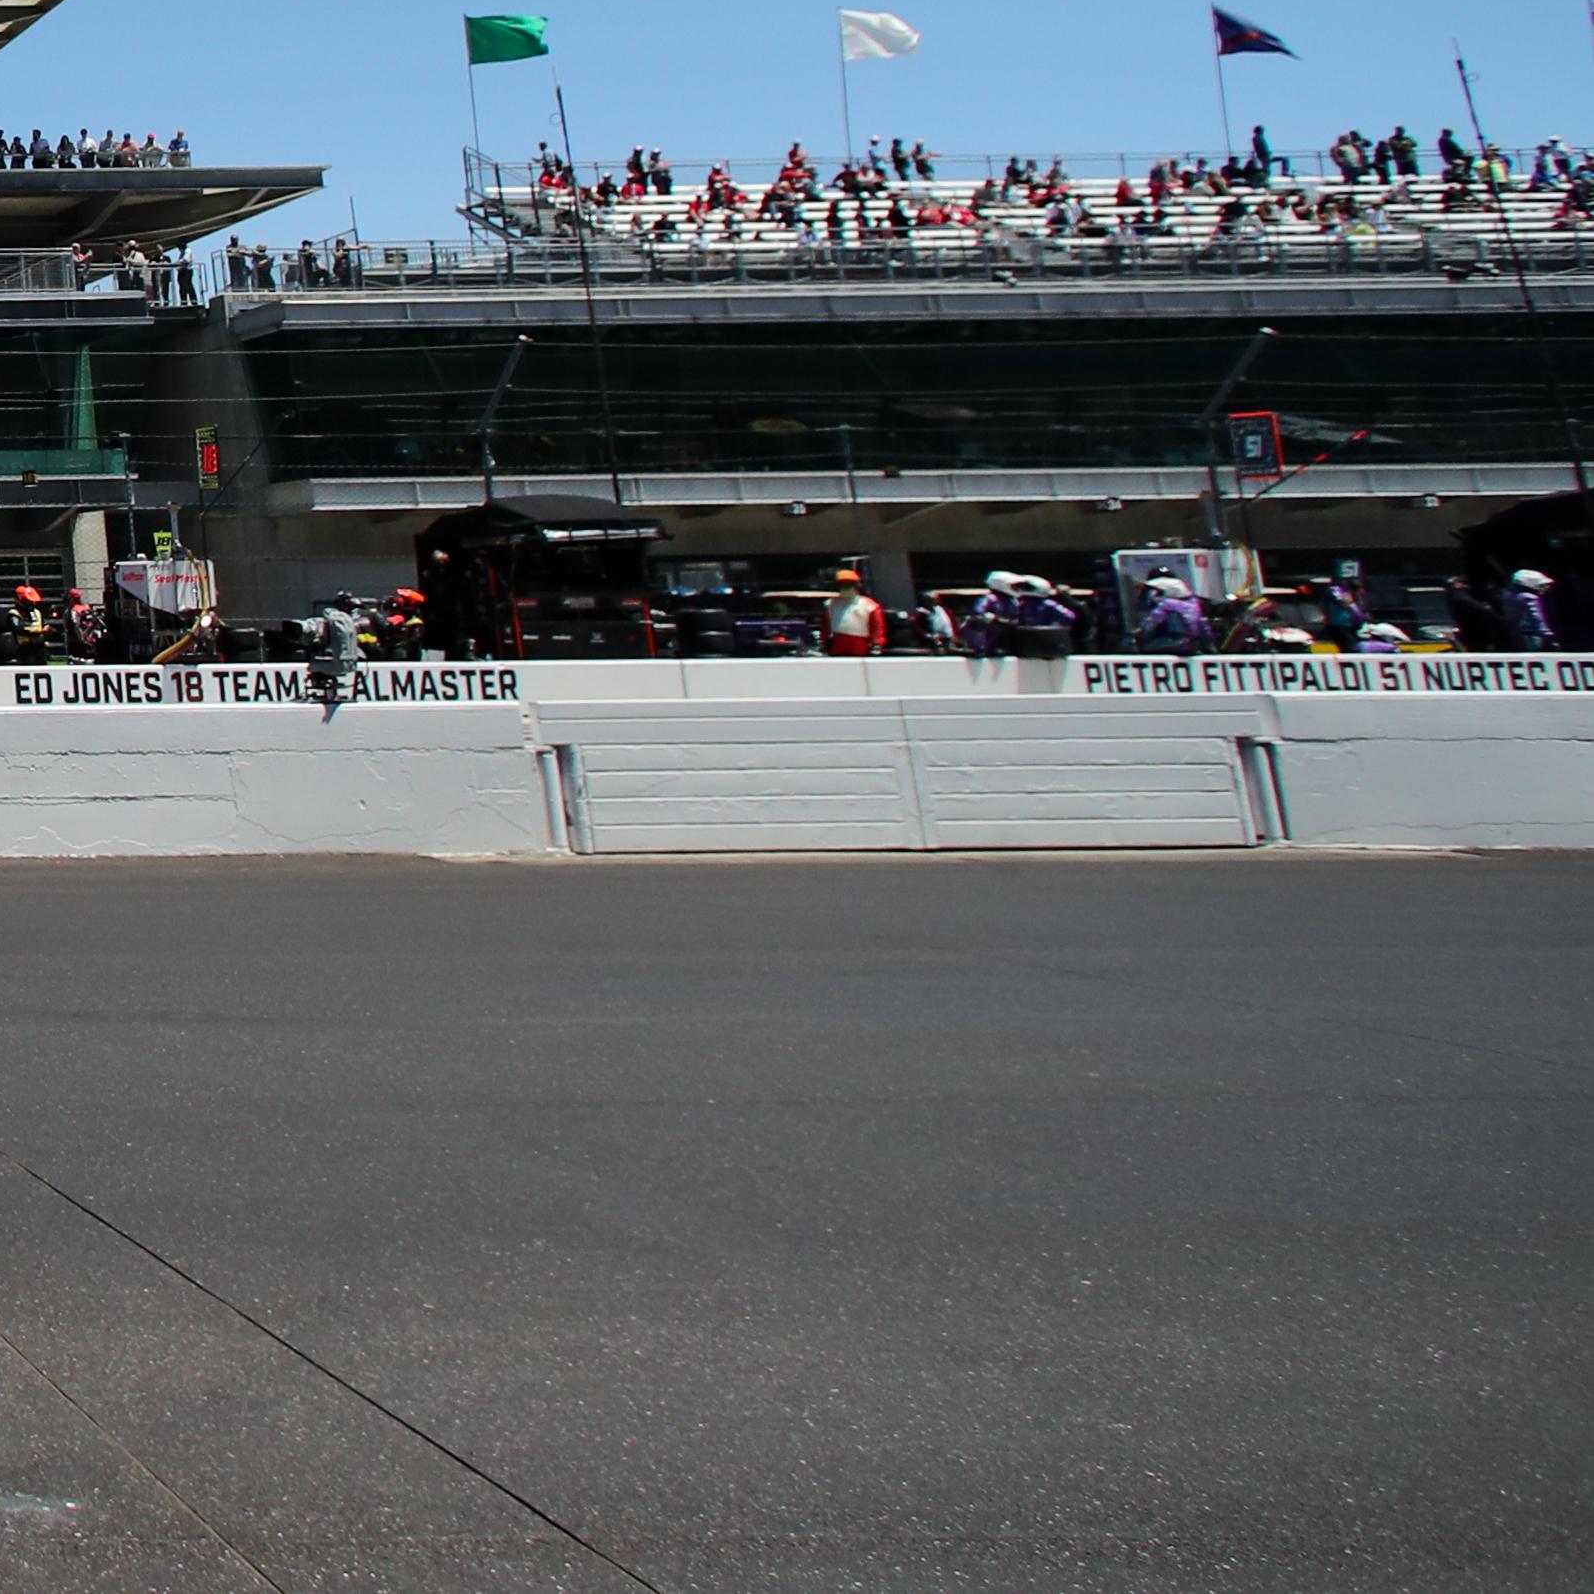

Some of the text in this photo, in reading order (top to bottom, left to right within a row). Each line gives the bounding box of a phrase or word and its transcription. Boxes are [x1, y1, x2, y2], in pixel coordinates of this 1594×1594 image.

[156, 536, 172, 547] 18
[14, 673, 53, 704] ED
[63, 672, 163, 704] JONES
[170, 671, 204, 703] 18
[212, 670, 300, 703] TEAM
[1083, 662, 1193, 693] PIETRO
[1202, 661, 1371, 692] FITTIPALDI
[1379, 661, 1411, 692] 51
[1421, 661, 1549, 692] NURTEC
